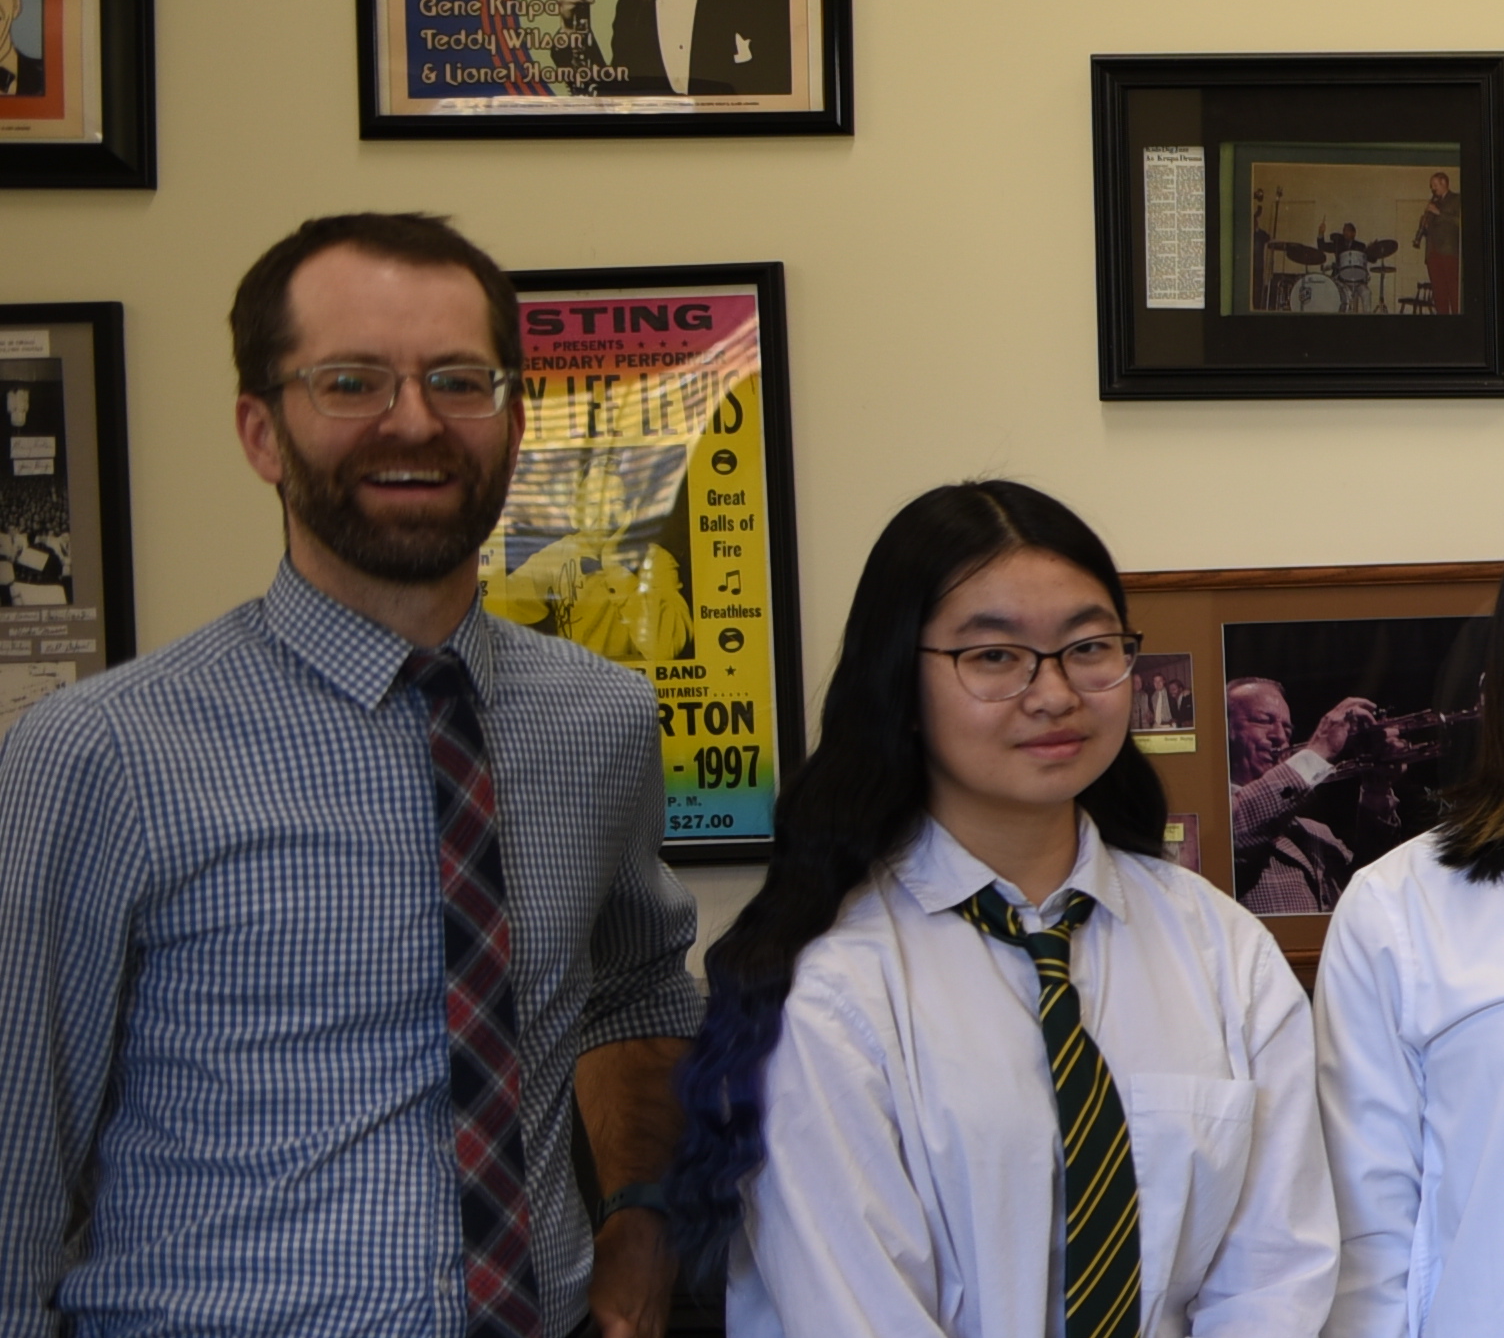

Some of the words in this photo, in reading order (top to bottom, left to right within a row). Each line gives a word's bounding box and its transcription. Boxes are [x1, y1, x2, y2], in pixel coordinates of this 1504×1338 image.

[419, 28, 496, 55] Teddy
[502, 27, 584, 50] Wilson
[420, 63, 438, 84] &
[445, 63, 516, 85] Lionel
[521, 63, 630, 86] Hampton
[526, 303, 713, 336] STING
[552, 340, 625, 352] PRESENTS
[566, 374, 625, 440] LEE
[639, 369, 744, 437] LEWIS
[706, 489, 747, 507] Great
[700, 514, 735, 533] Balls
[739, 514, 755, 532] of
[712, 540, 742, 558] Fire
[700, 604, 762, 620] Breathless
[655, 665, 708, 681] BAND
[693, 744, 761, 790] 1997
[669, 813, 734, 831] $27.00
